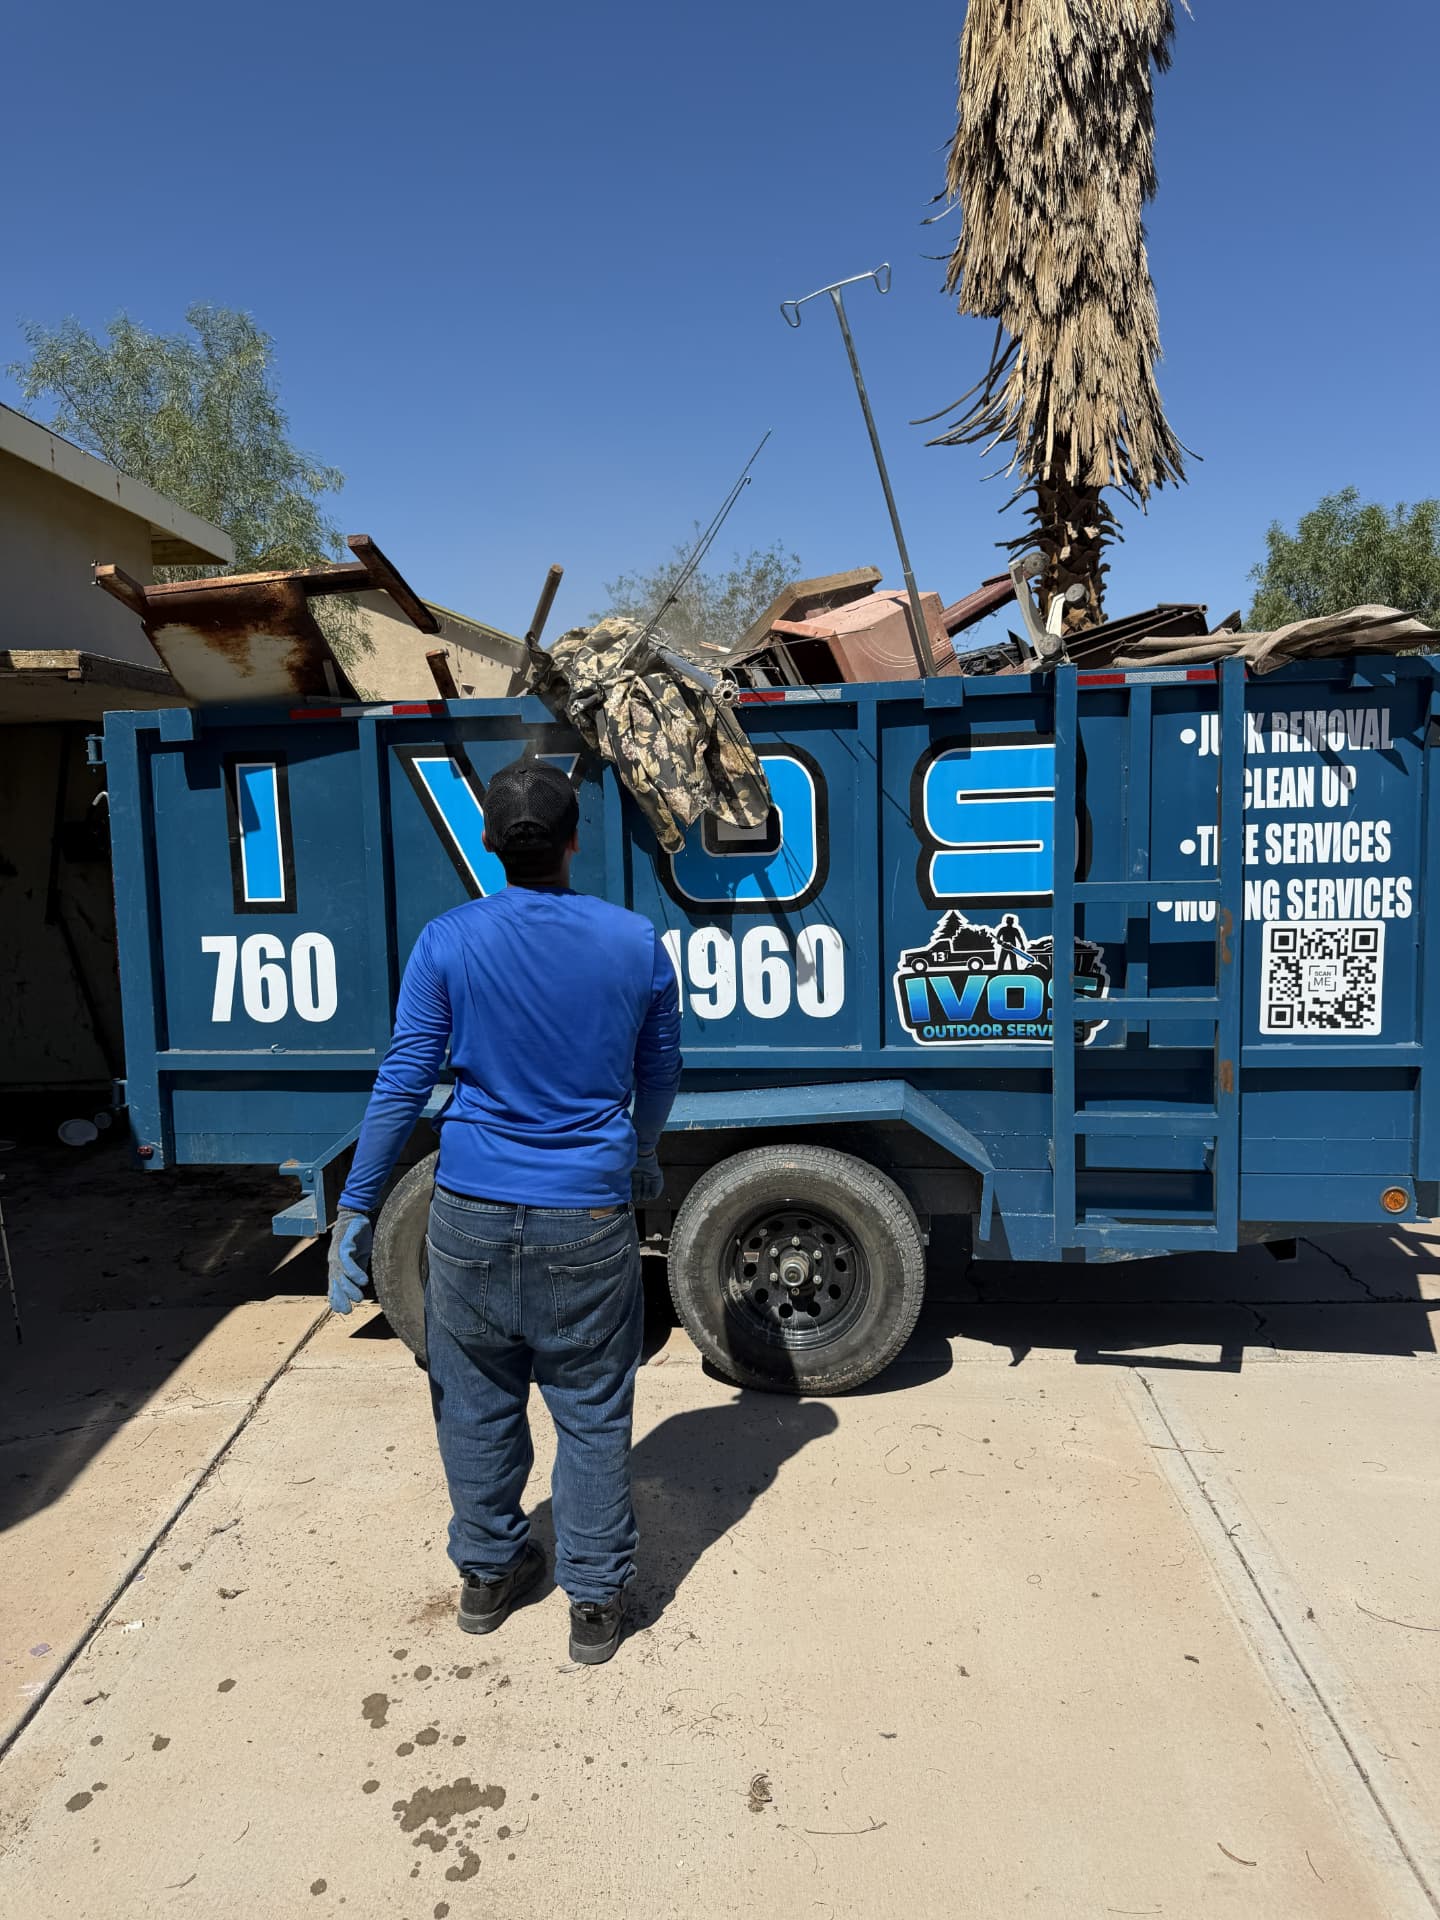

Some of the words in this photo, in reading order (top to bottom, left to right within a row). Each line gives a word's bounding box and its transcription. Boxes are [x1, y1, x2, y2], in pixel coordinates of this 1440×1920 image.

[1198, 713, 1265, 757] JUK
[1271, 708, 1393, 753] REMOVAL
[1321, 765, 1356, 807] UP
[1196, 823, 1259, 866] TIE
[1265, 820, 1391, 865] SERVICES
[1174, 879, 1280, 922] MONG
[1286, 876, 1412, 919] SERVICES
[200, 931, 338, 1023] 760
[931, 951, 946, 962] 13
[905, 974, 1098, 1023] IVO
[1313, 977, 1332, 986] ME
[923, 1024, 1003, 1038] OUTDOOR
[1007, 1023, 1084, 1038] SERVIS
